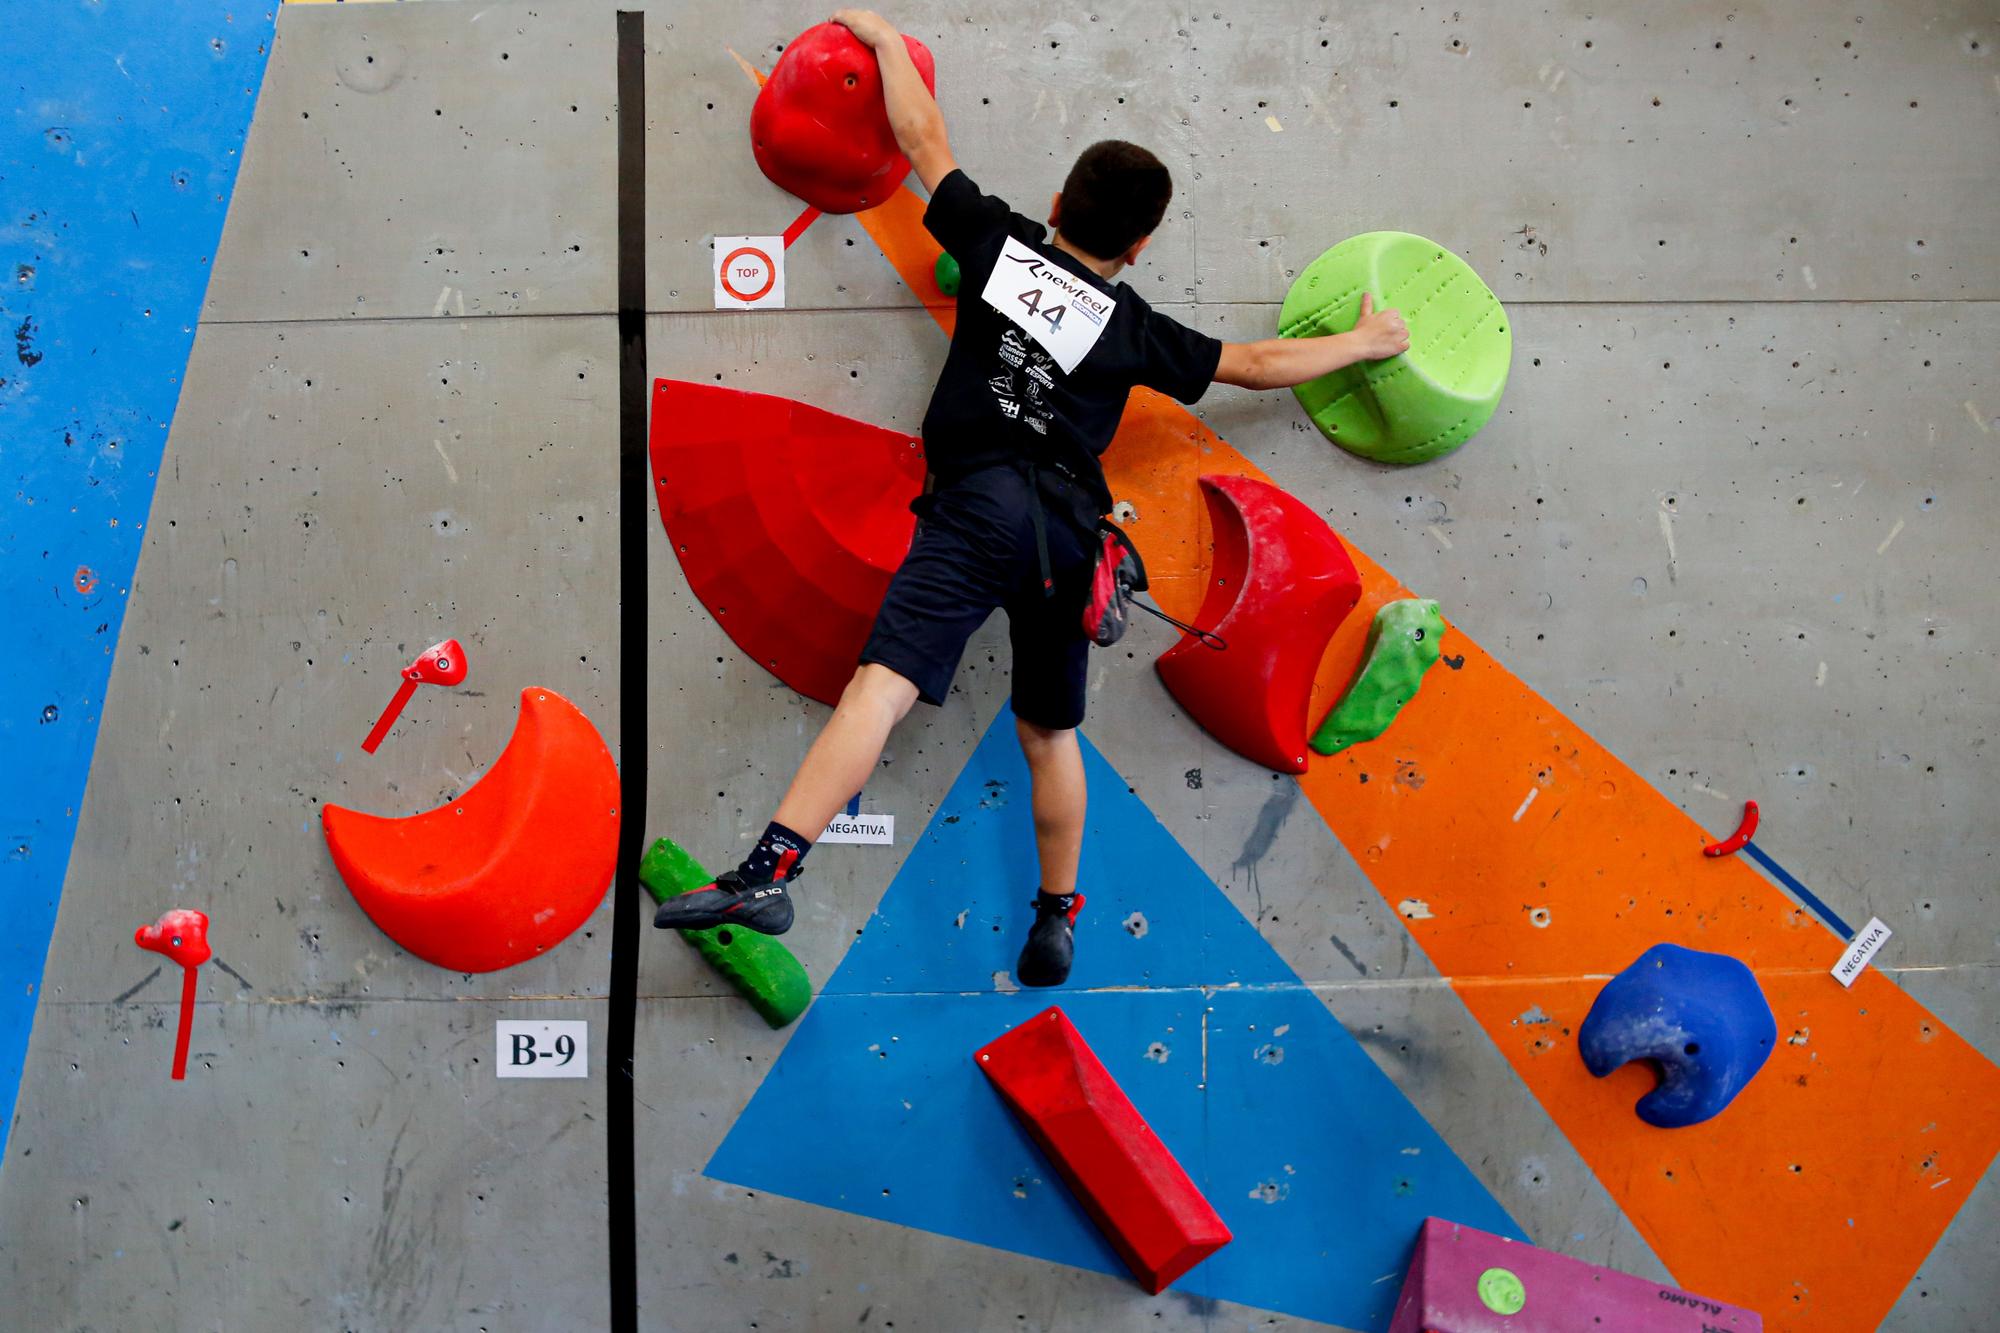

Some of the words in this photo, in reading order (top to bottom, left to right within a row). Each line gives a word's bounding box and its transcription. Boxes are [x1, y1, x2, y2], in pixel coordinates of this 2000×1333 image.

[736, 268, 759, 278] TOP
[1041, 270, 1110, 315] newfeel
[1017, 288, 1067, 335] 44
[826, 823, 887, 836] NEGATIVA
[1841, 928, 1884, 977] NEGATIVA
[508, 1033, 576, 1068] B-9
[1658, 1290, 1722, 1317] ALAMO
